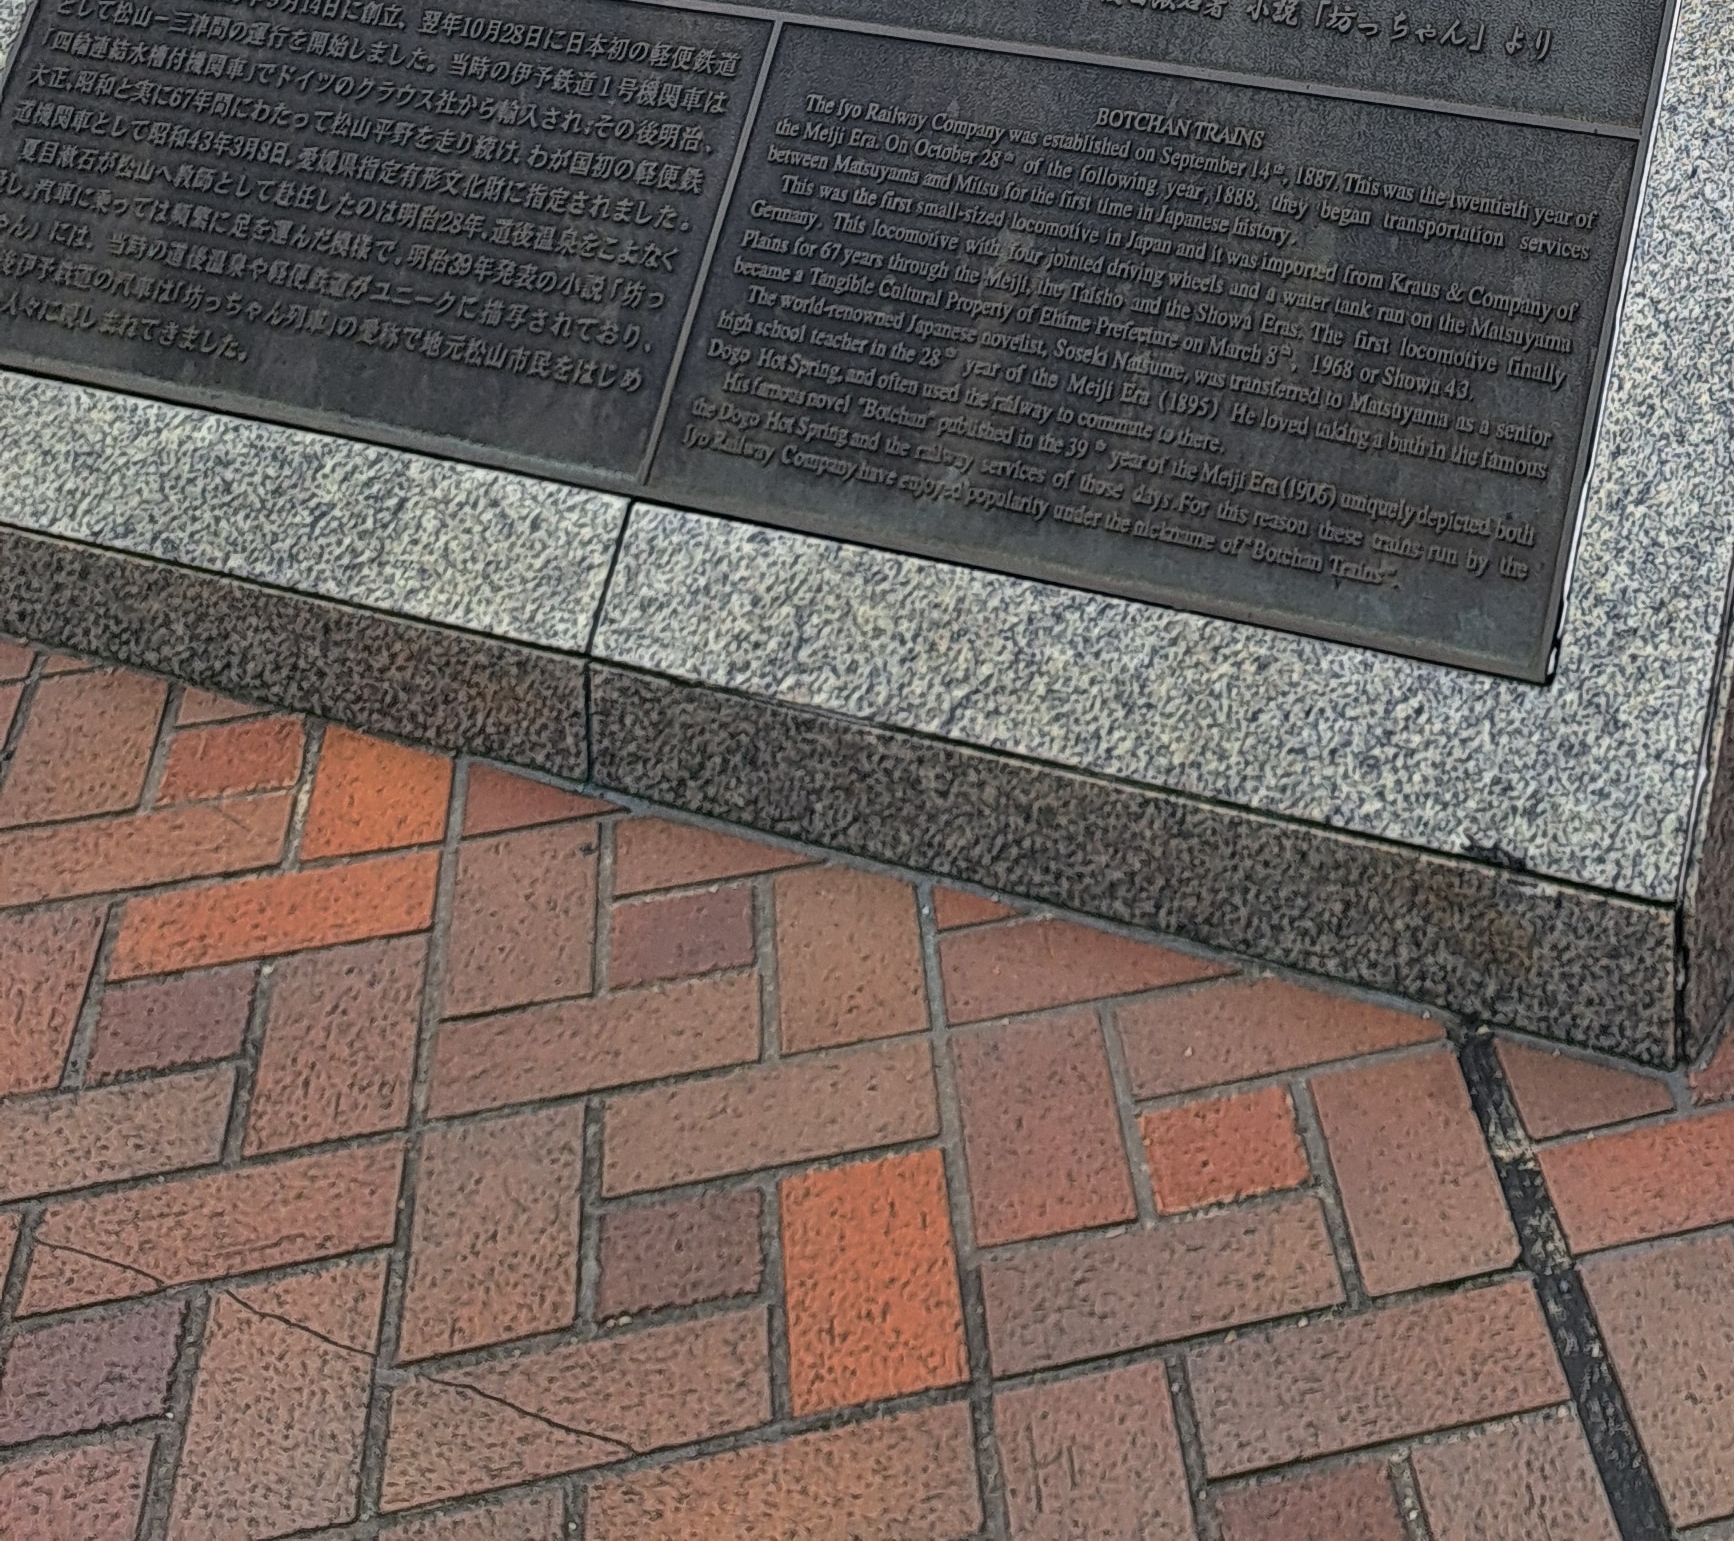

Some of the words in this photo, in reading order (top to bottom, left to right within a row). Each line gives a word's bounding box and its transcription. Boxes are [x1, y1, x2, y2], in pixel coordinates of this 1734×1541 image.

[764, 143, 830, 171] between
[831, 154, 921, 185] Matsuyama
[921, 170, 953, 190] and
[952, 172, 1001, 198] Mitsu
[1001, 180, 1030, 202] for
[1029, 184, 1055, 206] the
[1056, 188, 1094, 212] first
[1094, 194, 1134, 219] time
[1135, 201, 1155, 222] in
[1154, 204, 1230, 234] Japanese
[773, 116, 801, 138] the
[801, 120, 847, 149] Meiji
[846, 127, 880, 151] Era.
[881, 133, 910, 155] On
[911, 137, 978, 166] October
[1021, 156, 1043, 176] of
[1045, 158, 1074, 181] the
[1269, 192, 1309, 222] they
[1317, 200, 1373, 229] began
[1381, 209, 1507, 247] transportation
[1517, 236, 1591, 261] services
[802, 92, 836, 116] The
[863, 101, 929, 134] Railway
[928, 111, 1006, 146] Company
[1005, 127, 1039, 146] was
[1040, 130, 1133, 160] established
[1132, 146, 1158, 164] on
[1157, 144, 1248, 177] September
[1340, 172, 1381, 197] This
[1380, 183, 1416, 202] was
[1531, 206, 1572, 227] year
[1573, 208, 1598, 229] of
[1093, 105, 1191, 139] BOTCHAN
[1190, 119, 1266, 150] TRAINS
[739, 228, 790, 254] Plains
[790, 236, 818, 259] for
[816, 241, 843, 263] 67
[838, 250, 885, 270] years
[885, 252, 952, 284] through
[952, 263, 980, 286] the
[1129, 296, 1162, 316] and
[1162, 299, 1192, 322] the
[1193, 304, 1253, 332] Showa
[1308, 323, 1345, 347] The
[1352, 330, 1391, 355] first
[1396, 338, 1499, 373] locomotive
[1504, 356, 1567, 390] finally
[777, 173, 815, 198] This
[815, 184, 850, 203] was
[850, 185, 878, 208] the
[878, 189, 916, 214] first
[914, 200, 1008, 229] small-sized
[1008, 210, 1101, 244] locomotive
[1102, 225, 1123, 248] in
[1123, 228, 1173, 258] Japan
[1173, 239, 1209, 261] and
[1208, 242, 1226, 264] it
[1224, 250, 1259, 270] was
[1259, 250, 1340, 283] imported
[1340, 263, 1385, 290] from
[1387, 271, 1442, 299] Kraus
[1444, 280, 1467, 303] &
[1465, 283, 1553, 323] Company
[1555, 300, 1580, 322] of
[829, 210, 867, 236] This
[869, 217, 961, 251] locomotive
[962, 235, 1002, 258] with
[1005, 240, 1044, 265] four
[1042, 246, 1106, 275] jointed
[1104, 256, 1165, 290] driving
[1165, 268, 1225, 295] wheels
[1227, 279, 1262, 301] and
[1278, 288, 1330, 312] water
[1333, 293, 1375, 319] tank
[1408, 311, 1434, 329] on
[1435, 310, 1466, 335] the
[1468, 316, 1573, 352] Matsuyama
[731, 253, 792, 282] became
[805, 266, 876, 297] Tangible
[875, 278, 942, 308] Cultural
[943, 290, 1013, 326] Property
[1016, 304, 1038, 325] of
[1037, 306, 1092, 334] Ehime
[1180, 336, 1205, 354] on
[1205, 334, 1265, 364] March
[1309, 352, 1355, 380] 1968
[1356, 366, 1381, 385] or
[1379, 364, 1443, 395] Showa
[744, 284, 778, 308] The
[904, 312, 979, 344] Japanese
[1051, 339, 1110, 368] Soseki
[1191, 369, 1227, 389] was
[1228, 370, 1324, 406] transferred
[1323, 387, 1344, 410] to
[1346, 391, 1450, 429] Matsuyama
[1453, 416, 1476, 434] as
[1493, 423, 1553, 448] senior
